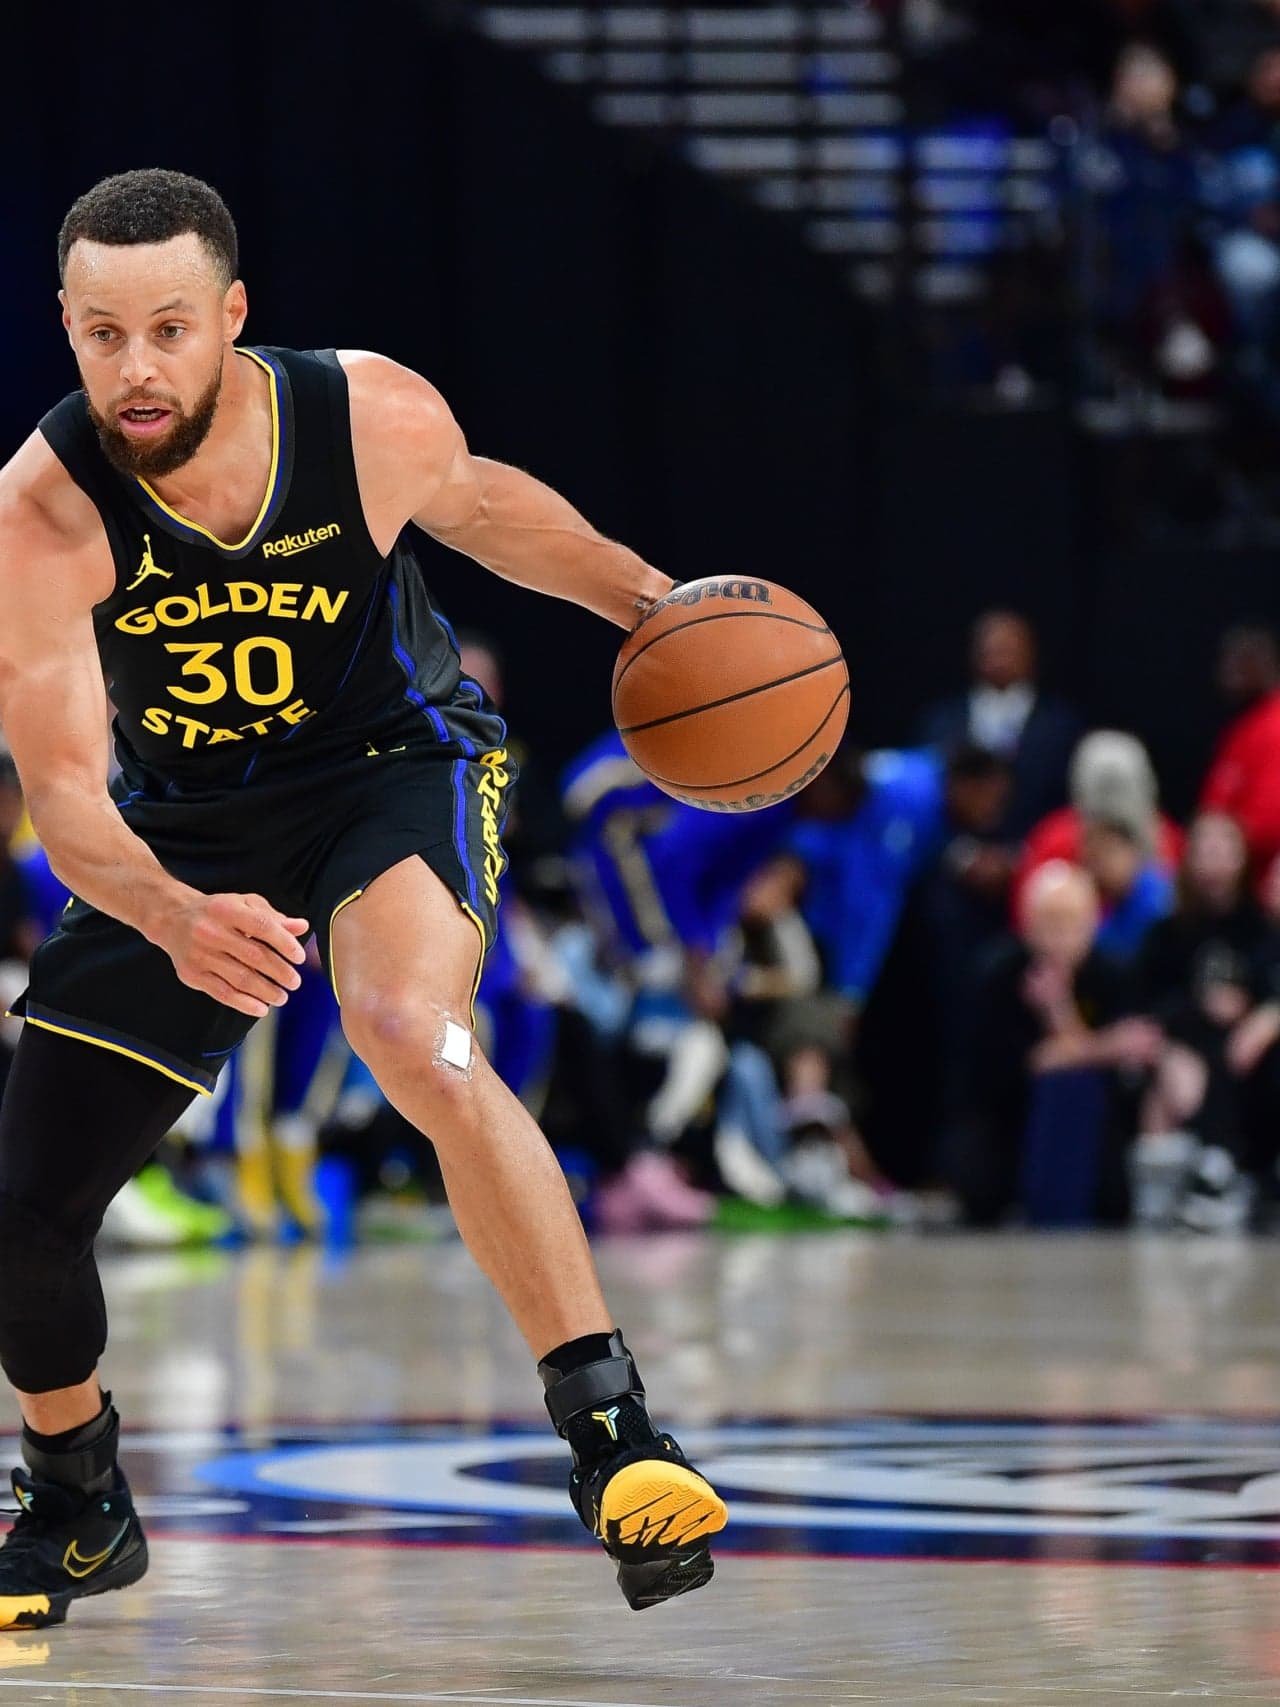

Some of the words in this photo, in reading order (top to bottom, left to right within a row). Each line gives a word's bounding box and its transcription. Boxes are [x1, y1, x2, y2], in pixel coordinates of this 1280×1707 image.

[262, 523, 341, 559] Rakuten
[114, 581, 349, 635] GOLDEN
[163, 636, 294, 706] 30
[141, 699, 318, 749] STATE
